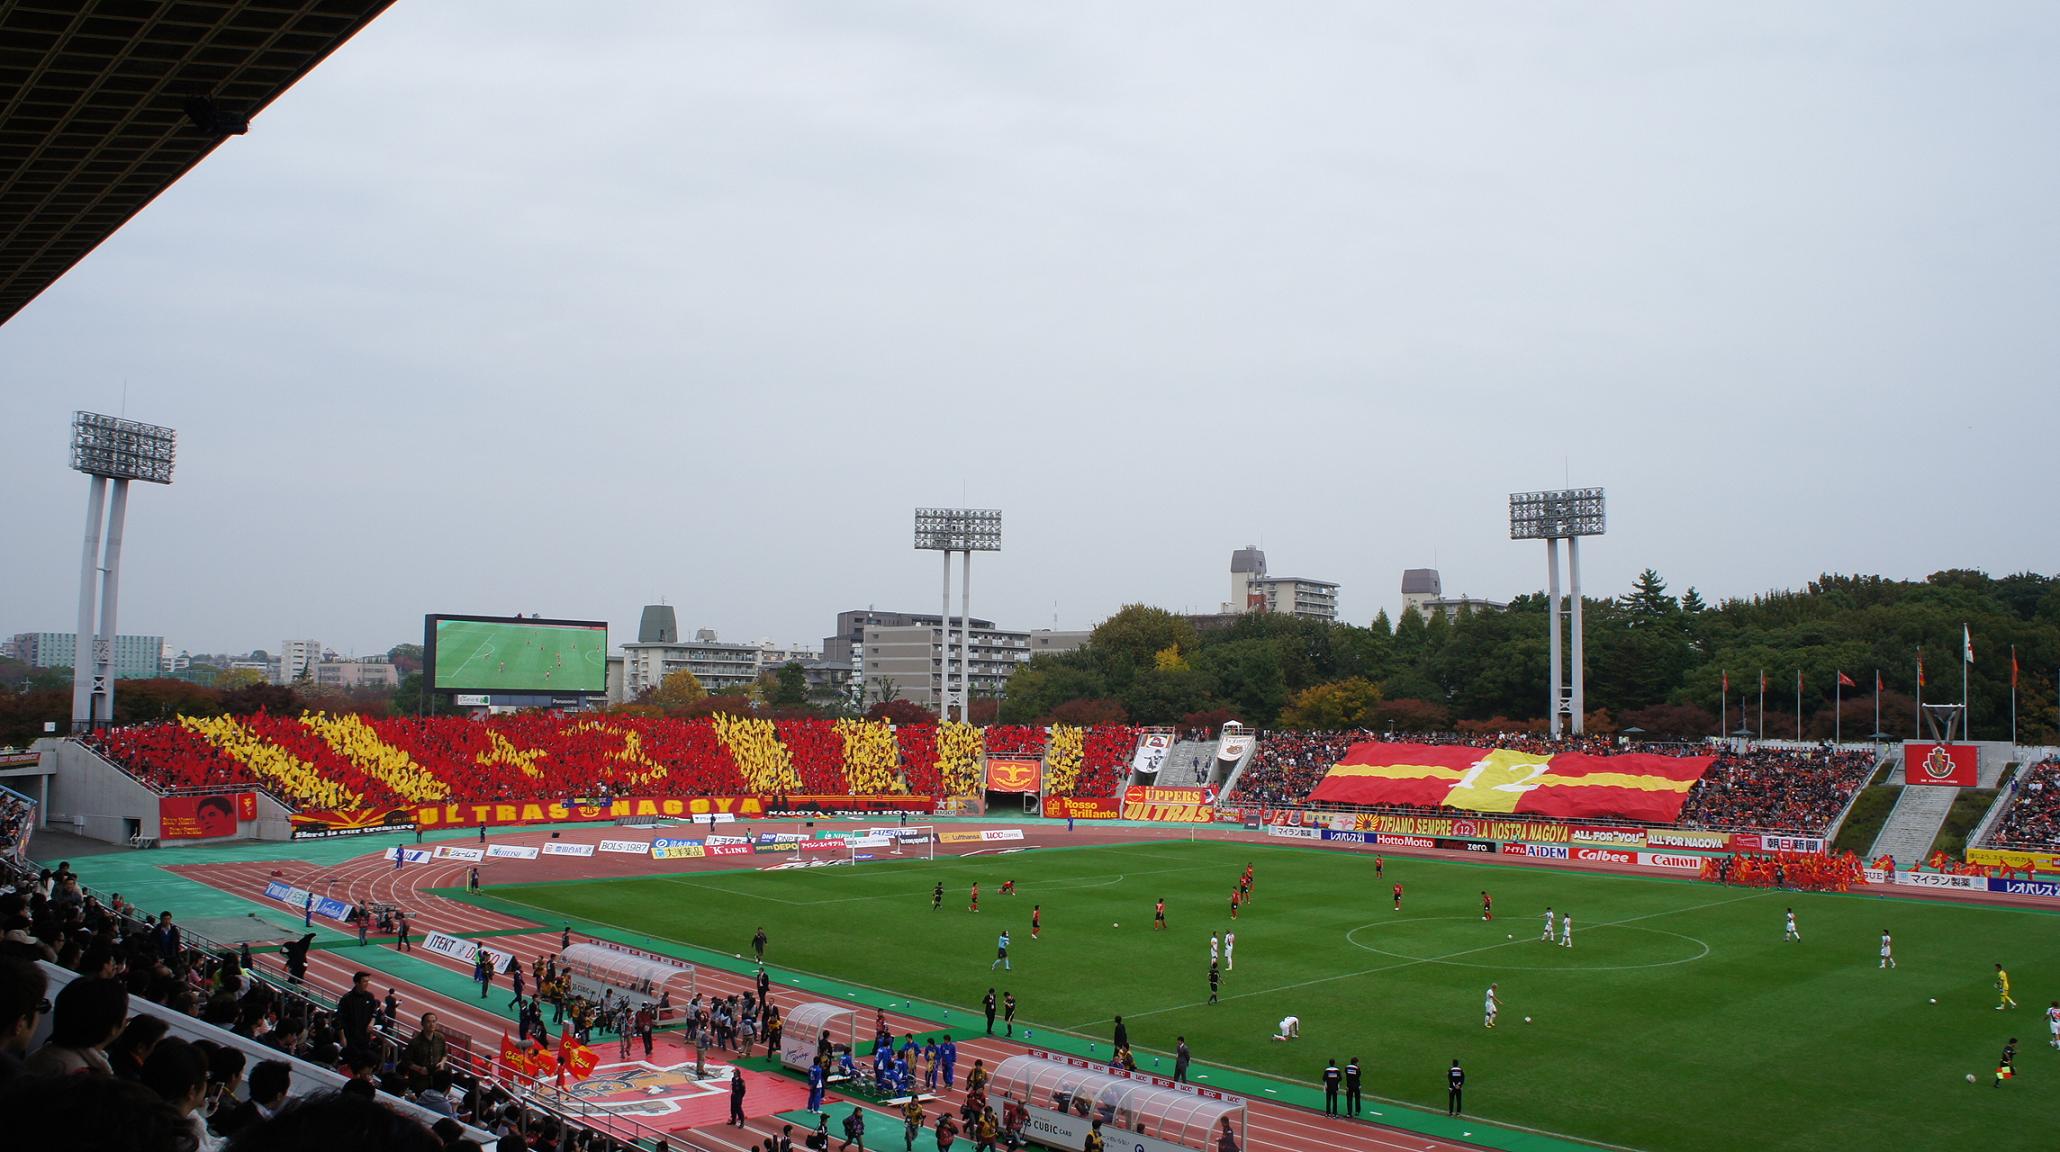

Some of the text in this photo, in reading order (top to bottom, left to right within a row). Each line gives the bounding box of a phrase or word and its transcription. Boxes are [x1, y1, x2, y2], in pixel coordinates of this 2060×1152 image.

[1063, 797, 1097, 809] Rosso
[418, 803, 569, 824] ULTRAS
[610, 798, 762, 816] NAGOYA
[1070, 809, 1117, 818] Brillante
[1124, 804, 1213, 822] ULTRAS
[1379, 816, 1414, 834] TIFIAMO
[1416, 818, 1452, 836] SEMPRE
[1476, 821, 1488, 838] LA
[1490, 822, 1527, 840] NOSTRA
[1528, 824, 1569, 843] NAGOYA
[1330, 831, 1365, 843] レオパレス21
[1594, 831, 1613, 841] FOR
[773, 843, 798, 851] DEPO
[1467, 843, 1488, 851] zero
[1666, 837, 1684, 846] FOR
[1685, 838, 1723, 849] NAGOYA
[1767, 838, 1818, 851] 朝日新聞
[1578, 849, 1630, 863] Calbee
[1651, 854, 1697, 868] Canon
[1911, 874, 1971, 887] マイラン製薬
[1033, 1120, 1058, 1135] CUBIC
